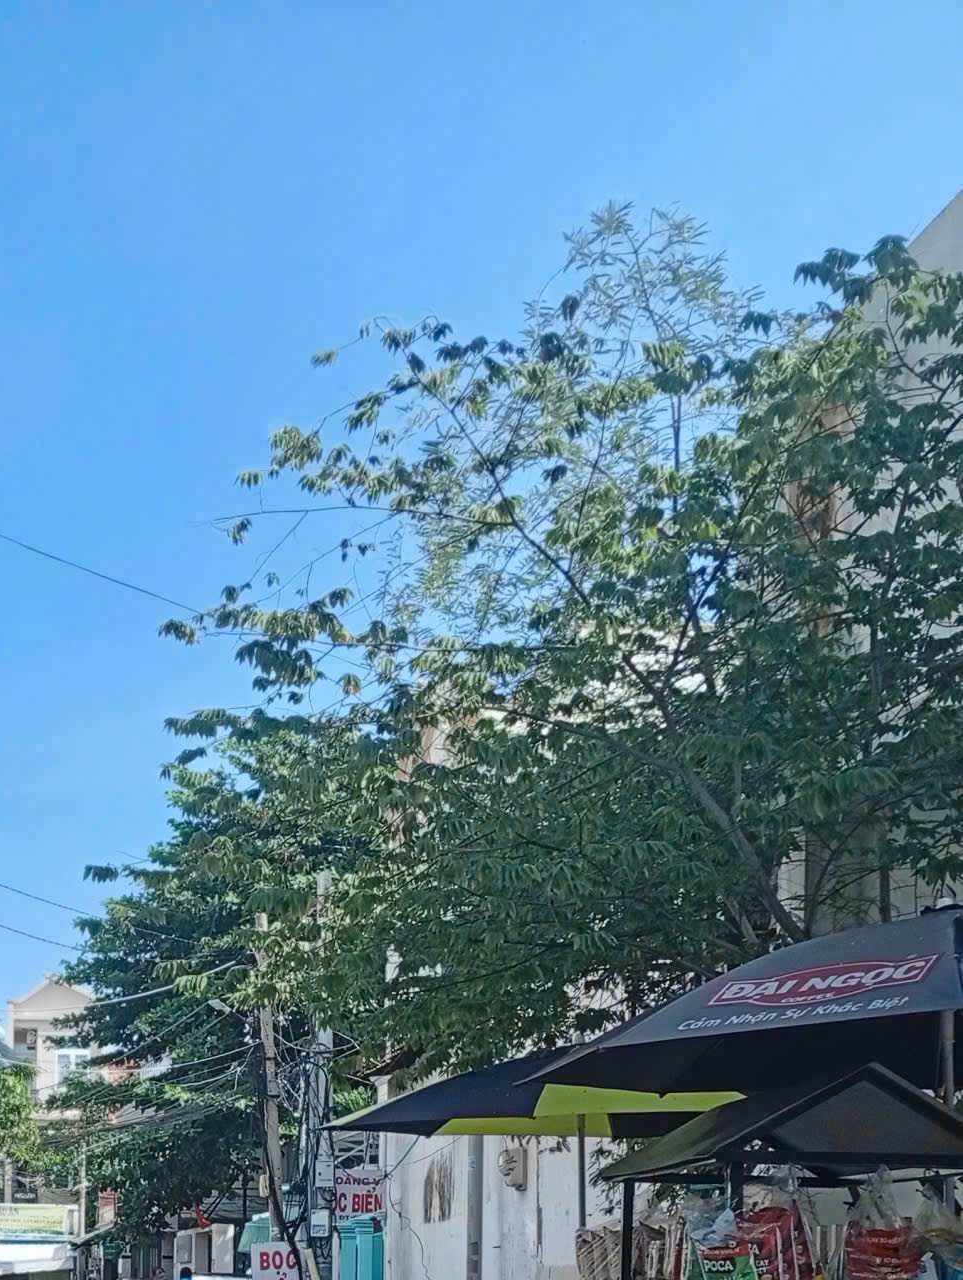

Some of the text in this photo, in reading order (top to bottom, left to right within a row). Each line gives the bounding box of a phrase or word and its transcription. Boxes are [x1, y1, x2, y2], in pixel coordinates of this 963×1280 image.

[721, 961, 926, 1000] ĐẠI NGỌC
[677, 995, 909, 1031] Cảm Nhận Sự Khác Biệt
[351, 1187, 383, 1213] BIỂN
[703, 1260, 734, 1272] POCA
